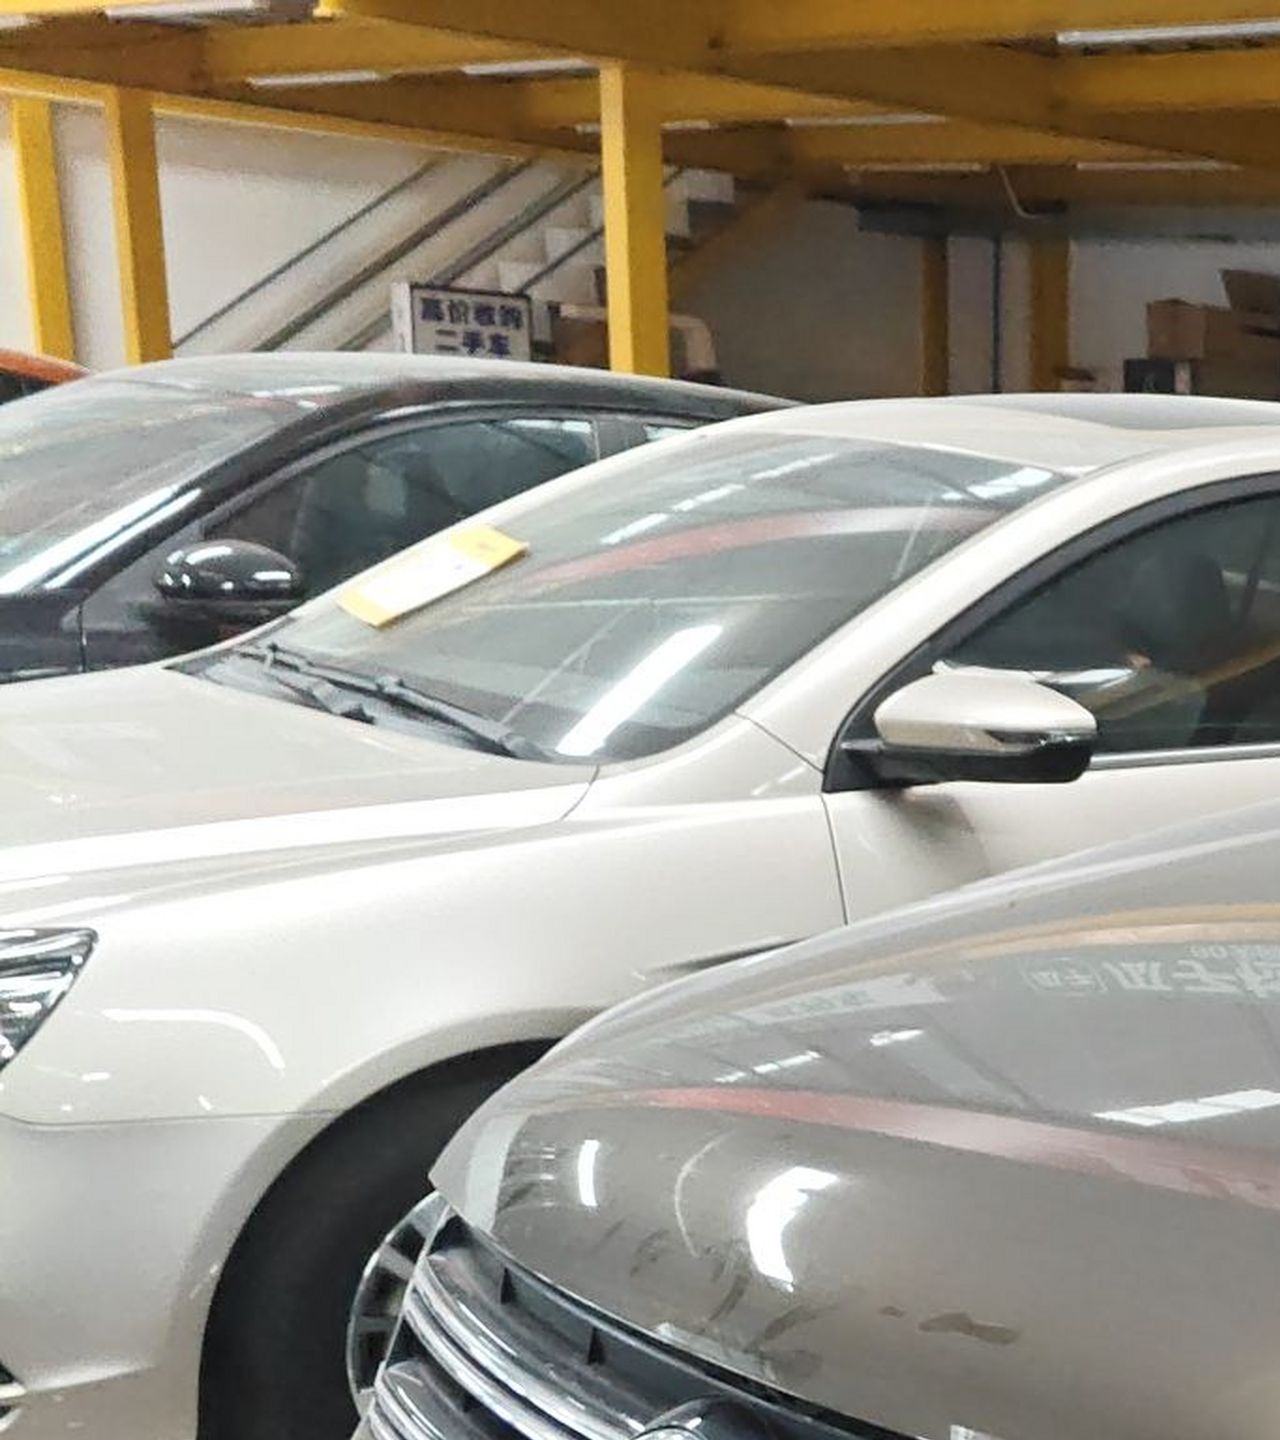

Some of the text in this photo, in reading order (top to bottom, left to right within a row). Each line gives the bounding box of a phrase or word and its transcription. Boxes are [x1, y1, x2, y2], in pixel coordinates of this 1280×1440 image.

[420, 298, 523, 329] 高价收购
[435, 329, 511, 356] 二手车
